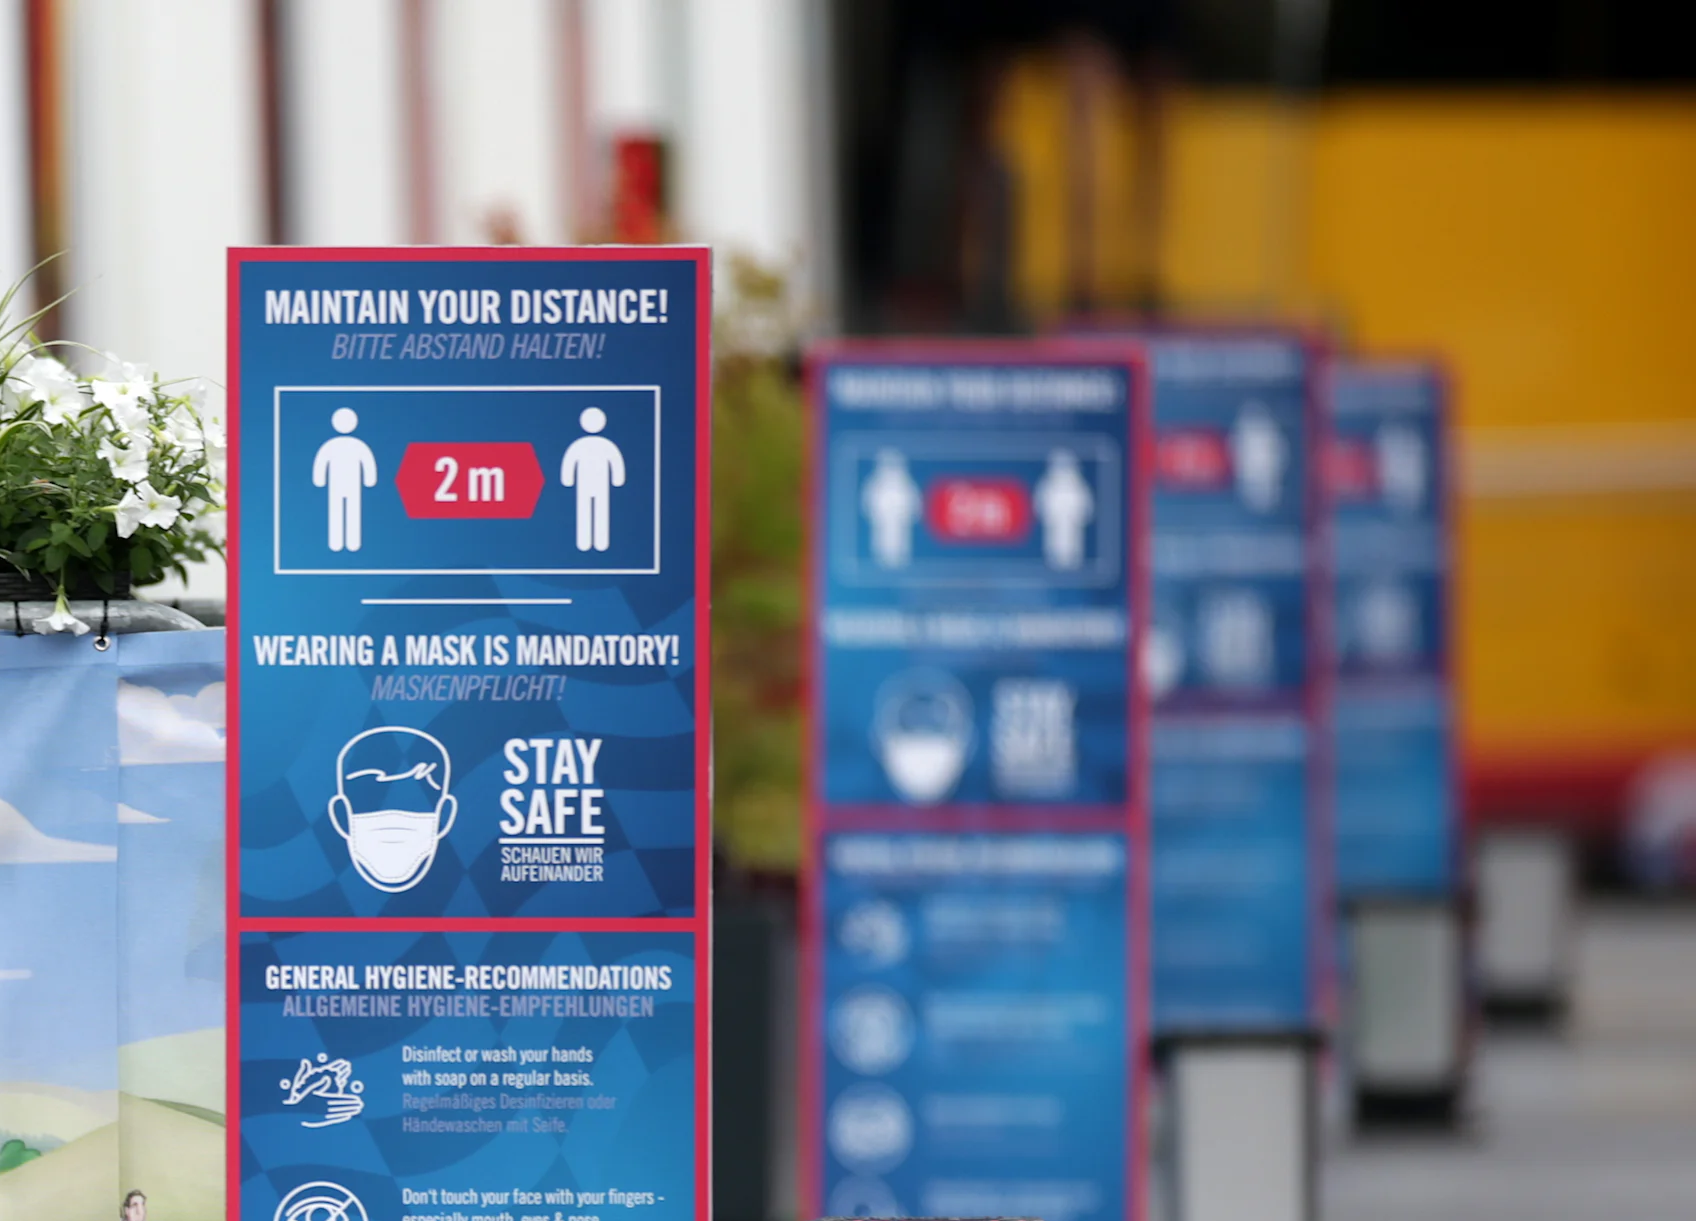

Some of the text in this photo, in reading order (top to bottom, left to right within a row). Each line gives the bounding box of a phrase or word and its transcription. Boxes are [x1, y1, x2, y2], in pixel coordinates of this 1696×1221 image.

[265, 288, 668, 325] MAINTAIN YOUR DISTANCE!
[331, 332, 607, 360] BITTE ABSTAND HALTEN!
[434, 456, 505, 502] 2 m
[253, 634, 680, 667] WEARING A MASK IS MANDATORY!
[370, 674, 568, 702] MASKENPFLICHT!
[503, 737, 603, 785] STAY
[499, 788, 606, 836] SAFE
[500, 846, 604, 864] SCHAUEN WIR
[500, 865, 604, 883] AUFEINANDER
[265, 964, 673, 991] GENERAL HYGIENE-RECOMMENDATIONS
[282, 994, 654, 1018] ALLGEMEINE HYGIENE-EMPFEHLUNGEN
[401, 1045, 594, 1066] Disinfect or wash your hands
[401, 1069, 594, 1090] with soap on a regular basis.
[499, 1092, 584, 1110] Desinfizieren
[586, 1093, 617, 1110] oder
[401, 1116, 569, 1134] Händewaschen mit Seife.
[440, 1188, 479, 1205] touch
[480, 1191, 511, 1208] your
[512, 1187, 543, 1205] face
[544, 1188, 575, 1205] with
[576, 1191, 606, 1208] your
[607, 1187, 655, 1209] fingers
